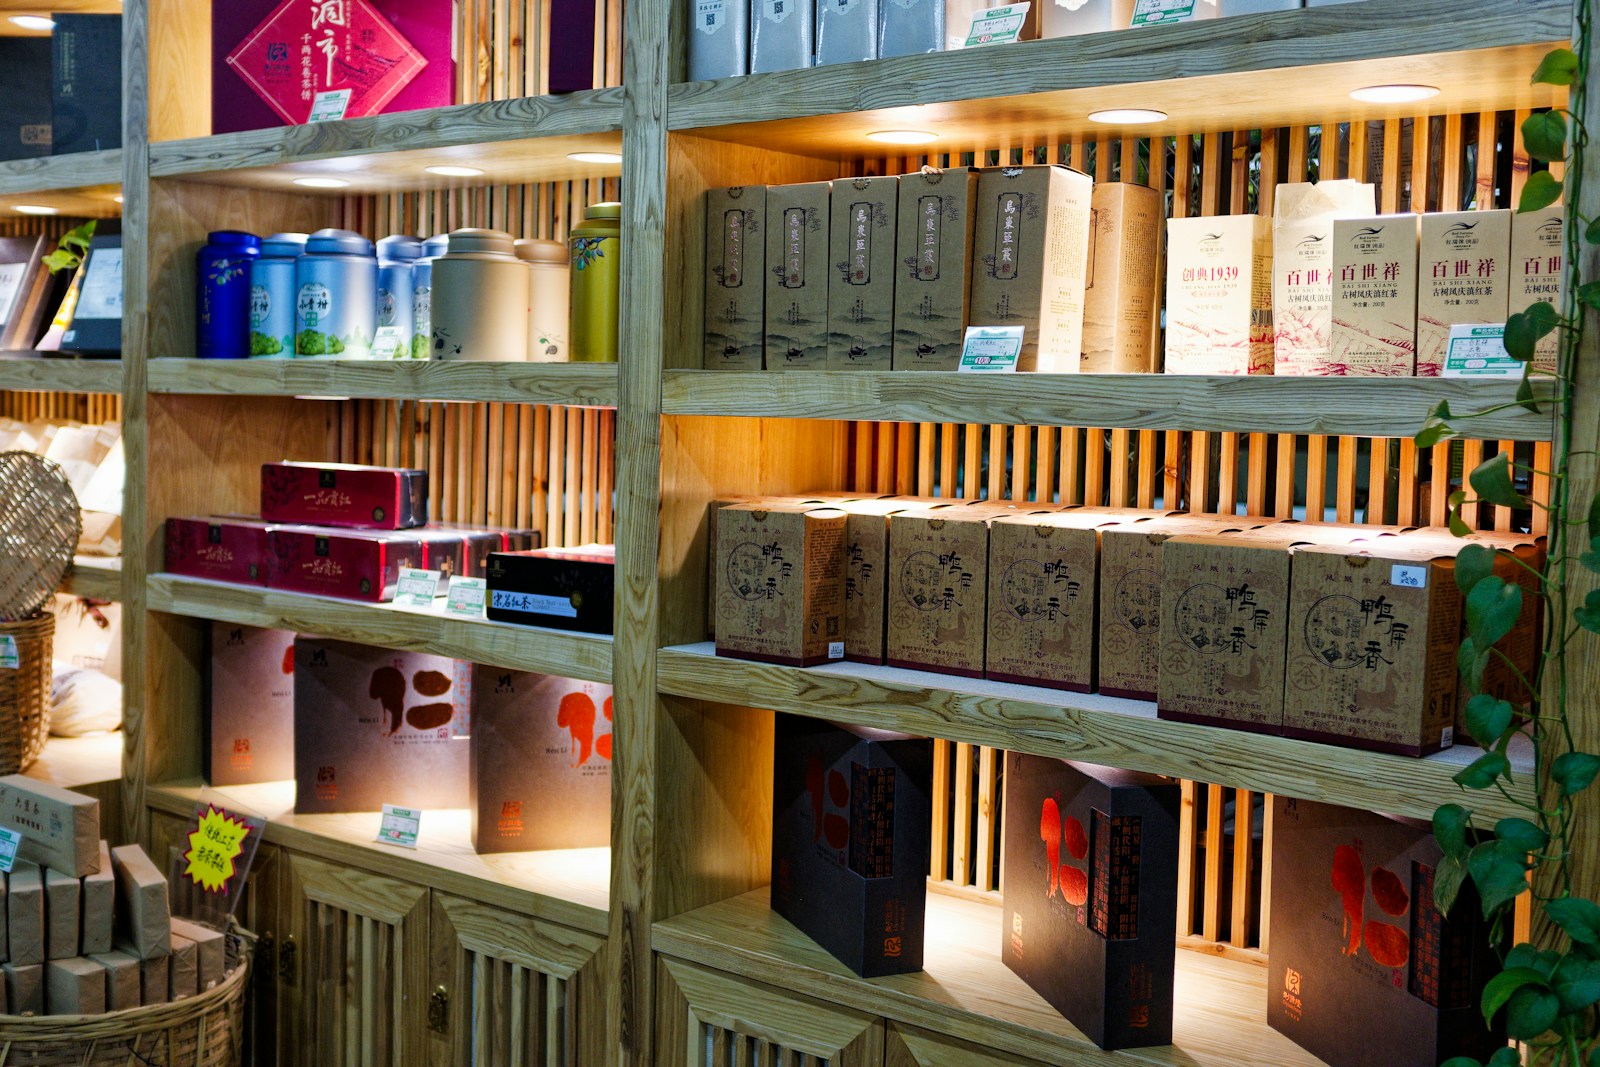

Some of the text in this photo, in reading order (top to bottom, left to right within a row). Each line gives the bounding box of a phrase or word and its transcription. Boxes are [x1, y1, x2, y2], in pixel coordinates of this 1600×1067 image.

[1182, 266, 1239, 282] 创典1939
[1340, 262, 1400, 282] 百世祥
[1431, 258, 1496, 278] 百世祥
[1342, 289, 1398, 299] 古树凤庆滇红茶
[1432, 286, 1493, 297] 古树凤庆滇红茶
